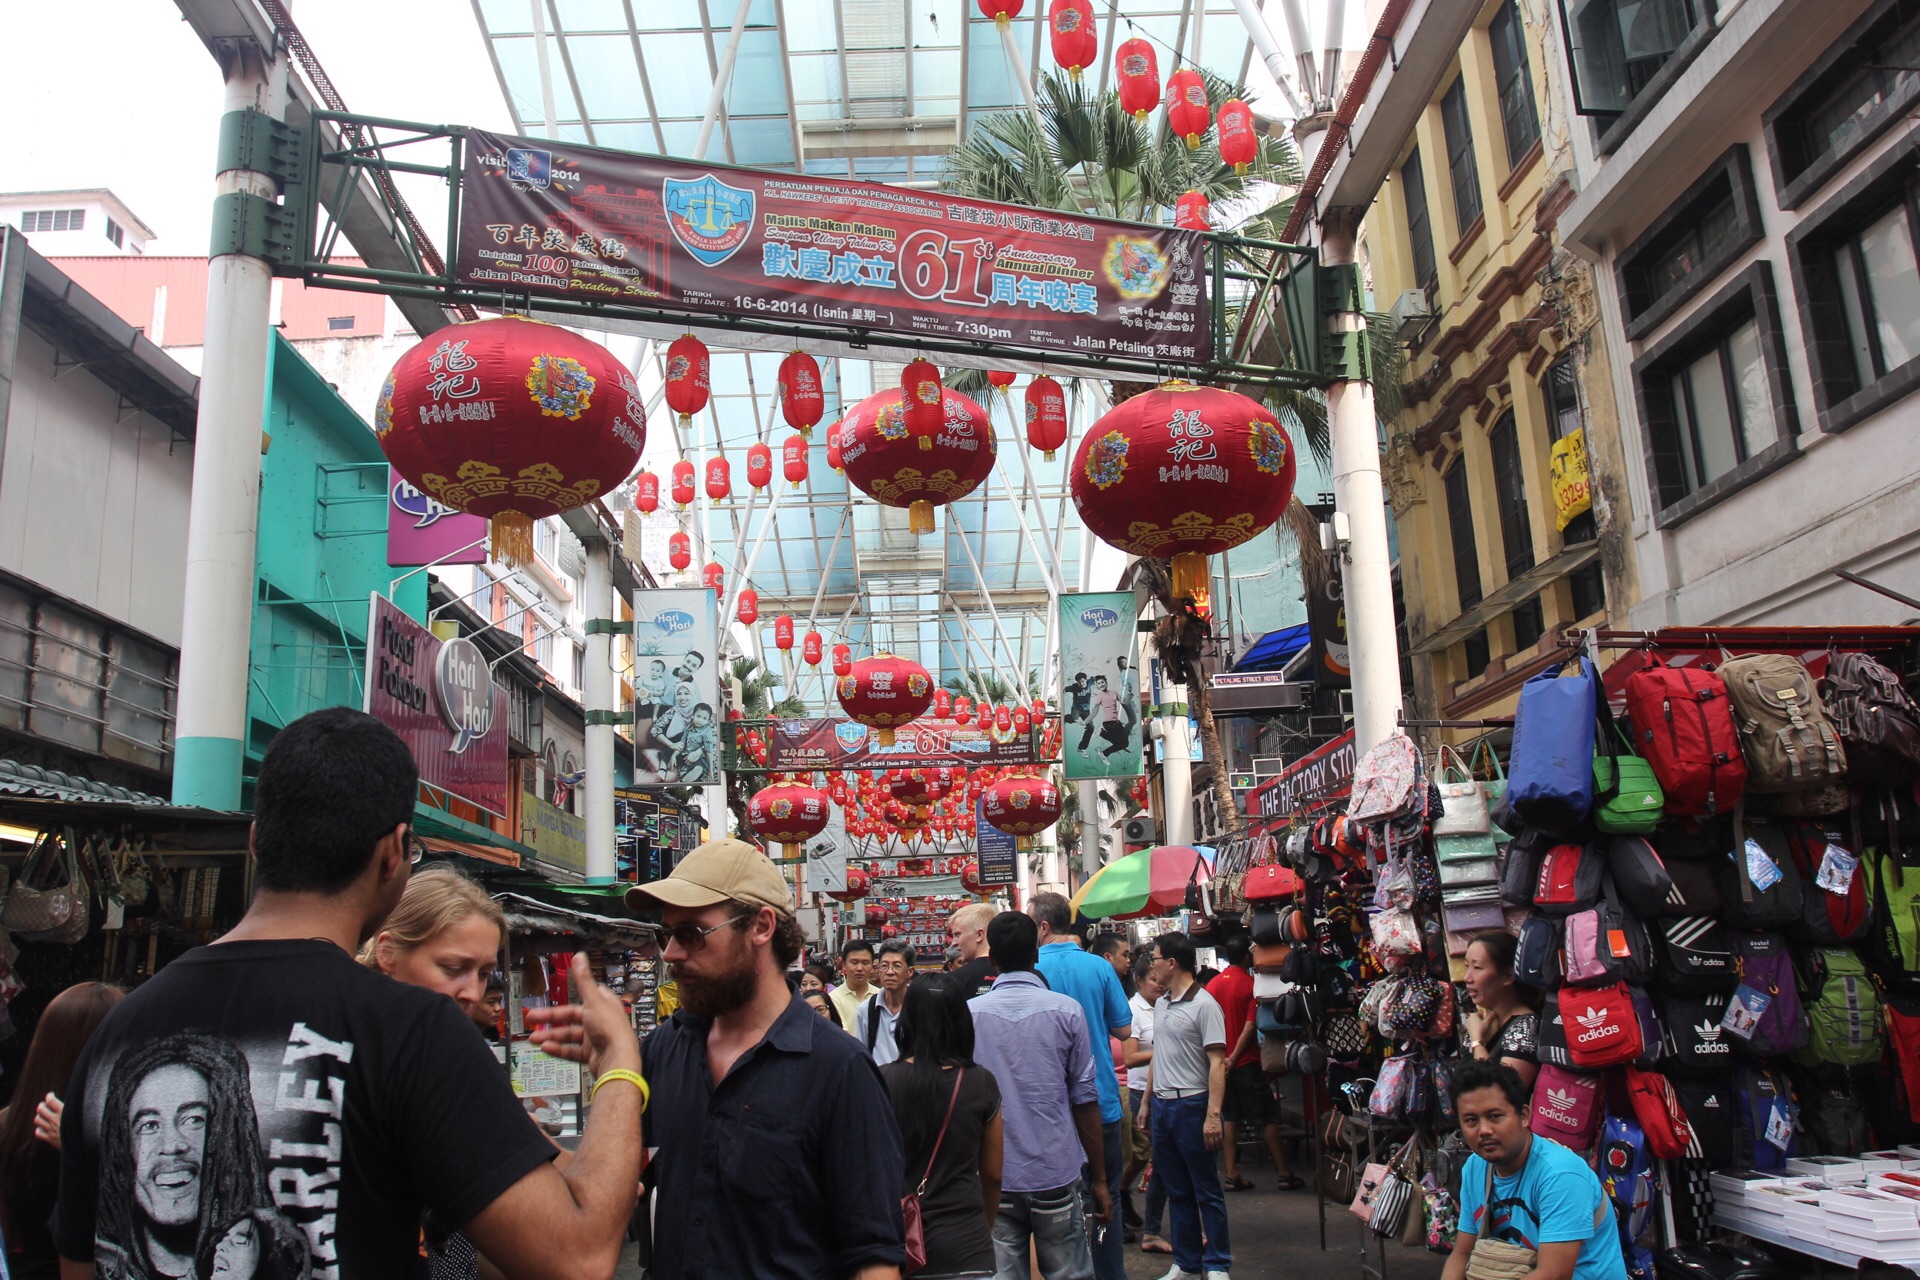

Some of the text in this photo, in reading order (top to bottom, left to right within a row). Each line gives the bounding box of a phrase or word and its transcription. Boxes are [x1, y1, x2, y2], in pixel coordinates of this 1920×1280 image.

[476, 154, 507, 168] visit
[551, 169, 581, 182] 2014
[763, 189, 780, 198] K.L.
[780, 191, 823, 202] HAWKERS'
[830, 196, 855, 206] PETTY
[894, 204, 943, 218] ASSOCIATION
[764, 180, 943, 208] PERSATUAN PENJAJA DAN PENIAGA KECIL K.L.
[765, 213, 896, 239] Majlis Makan Malam
[947, 204, 1095, 241] 吉隆坡小販商業公會
[486, 223, 628, 260] 百年茨廠街
[764, 227, 896, 252] Sempena Ulang Tahun Ke
[479, 250, 523, 262] Melebihi
[496, 260, 520, 269] Over
[523, 254, 568, 274] 100
[762, 241, 897, 289] 歡慶成立
[998, 244, 1077, 267] Anniversary
[571, 259, 639, 276] Tahun Sejarah
[994, 258, 1095, 280] Annual Dinner
[470, 268, 568, 289] Jalan Petaling
[570, 279, 661, 299] Petaling Street
[682, 290, 712, 299] TARIKH
[990, 271, 1098, 315] 周年晚宴
[704, 299, 726, 307] DATE
[733, 295, 894, 325] 16-6-2014 (Isnin 星期一)
[912, 315, 939, 324] WAKTU
[955, 321, 1012, 339] 7:30pm
[1029, 329, 1053, 337] TEMPAT
[1045, 337, 1066, 345] VENUE
[1073, 335, 1196, 358] Jalan Petaling 茨廠街
[658, 612, 679, 623] Hari
[1083, 609, 1104, 620] Hari
[1094, 616, 1116, 627] Hari
[669, 620, 690, 631] Hari
[448, 653, 477, 692] Hari
[462, 692, 490, 733] Hari
[1259, 787, 1279, 816] THE
[1279, 758, 1326, 814] FACTORY
[1577, 1024, 1620, 1043] adidas
[1694, 1042, 1729, 1054] adidas
[1538, 1105, 1578, 1127] adidas
